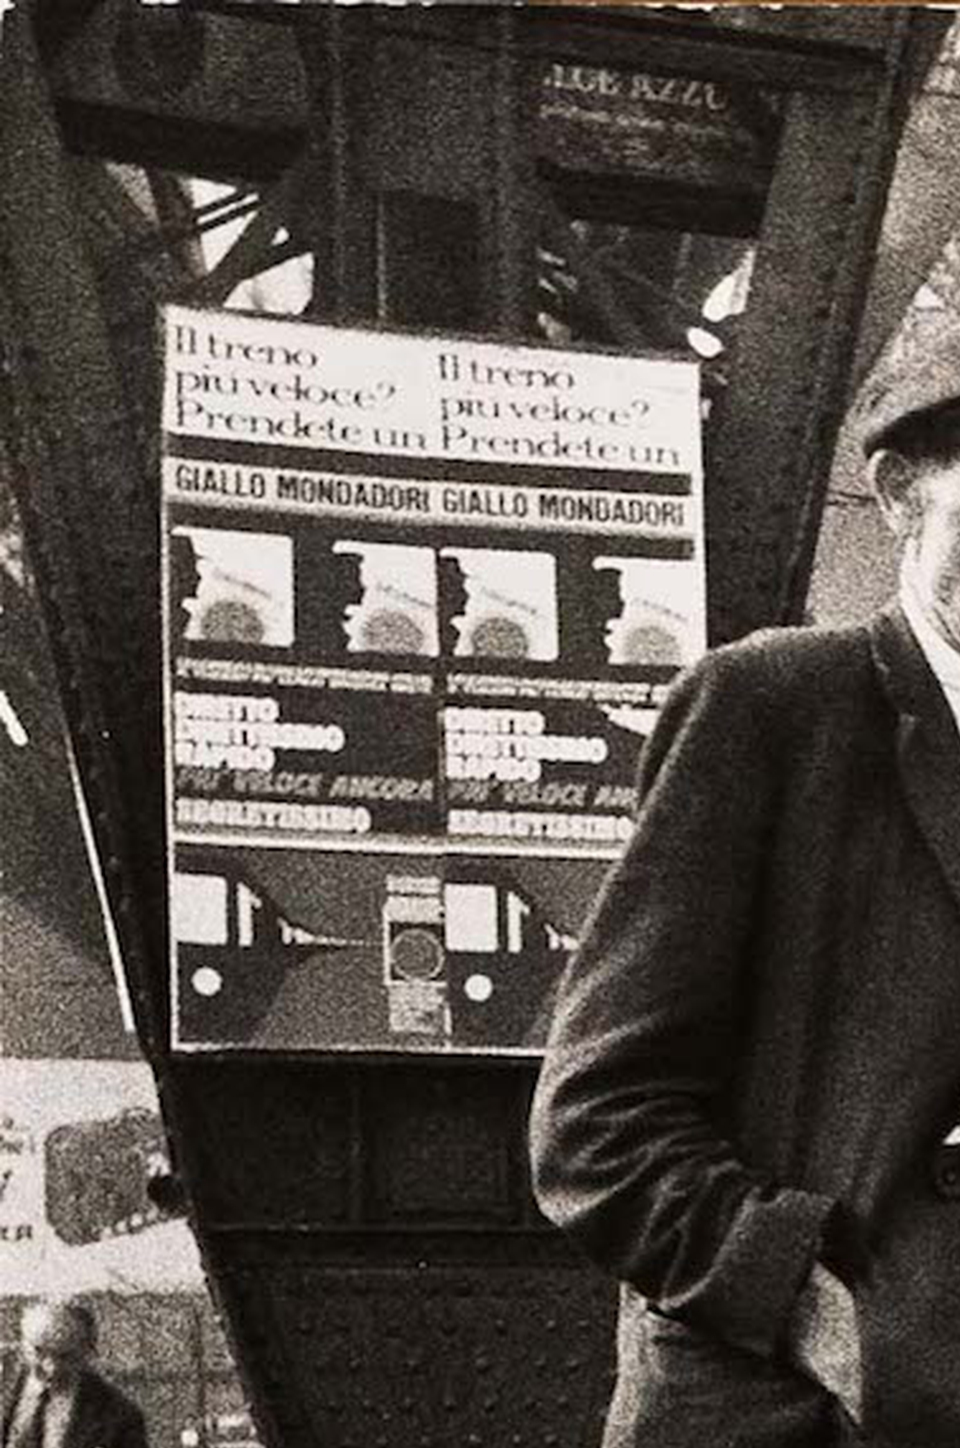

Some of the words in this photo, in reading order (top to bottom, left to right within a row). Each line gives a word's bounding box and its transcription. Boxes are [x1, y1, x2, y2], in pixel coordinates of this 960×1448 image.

[208, 332, 319, 367] treno
[247, 374, 397, 408] veloce?
[470, 359, 576, 389] treno
[176, 399, 361, 442] Prendete
[374, 428, 427, 451] un
[507, 396, 650, 424] veloce?
[441, 424, 618, 458] Prendete
[629, 445, 681, 467] un
[175, 464, 267, 500] GIALLO
[276, 475, 432, 513] MONDADORI
[442, 488, 530, 518] GIALLO
[537, 498, 686, 528] MONDADORI
